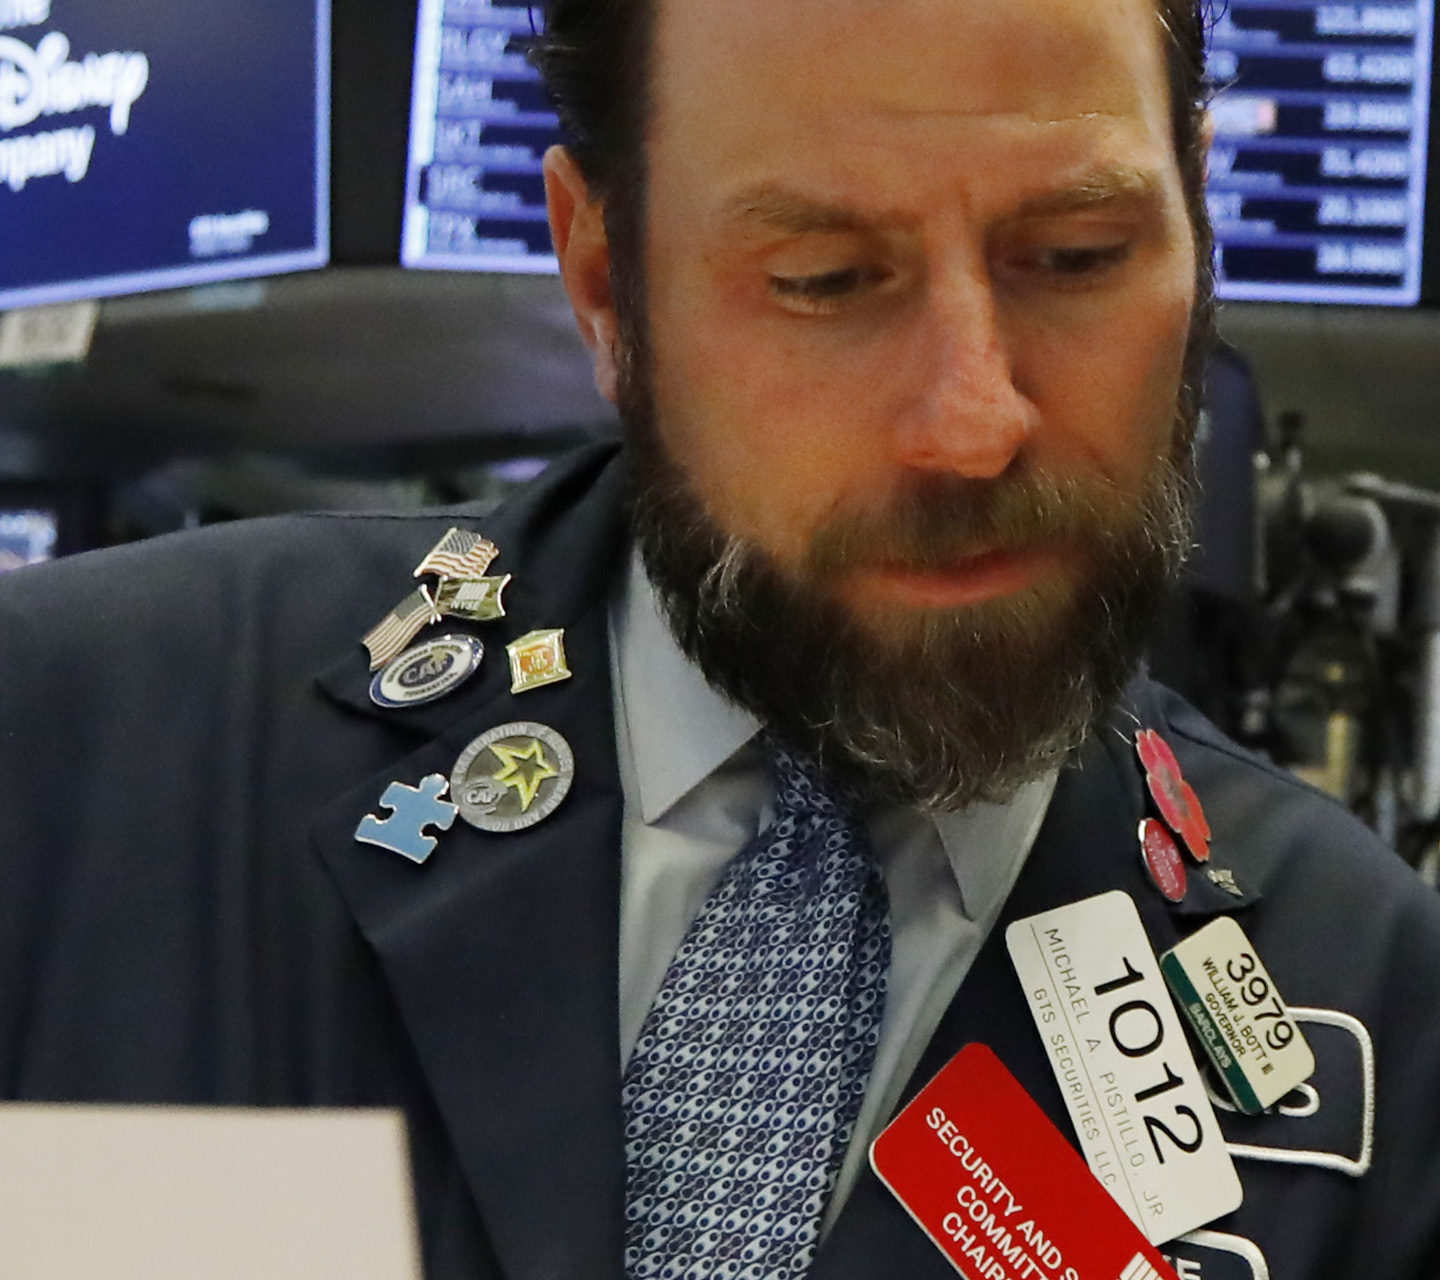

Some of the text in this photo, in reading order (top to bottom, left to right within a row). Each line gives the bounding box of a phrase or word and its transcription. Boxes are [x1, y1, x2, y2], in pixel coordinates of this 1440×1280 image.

[1094, 956, 1204, 1165] 1012
[1189, 1002, 1233, 1069] BARCLAYS
[1202, 957, 1238, 1013] WILLIAM
[1233, 1014, 1245, 1026] J.
[1240, 1025, 1268, 1061] BOTT
[1205, 992, 1247, 1058] GOVERNOR
[1226, 953, 1294, 1051] 3979
[1032, 988, 1118, 1186] GTS SECURITIES LLC
[1044, 928, 1091, 1025] MICHAEL
[1143, 1189, 1165, 1218] JR
[925, 1107, 1023, 1217] SECURITY
[1016, 1220, 1063, 1271] AND
